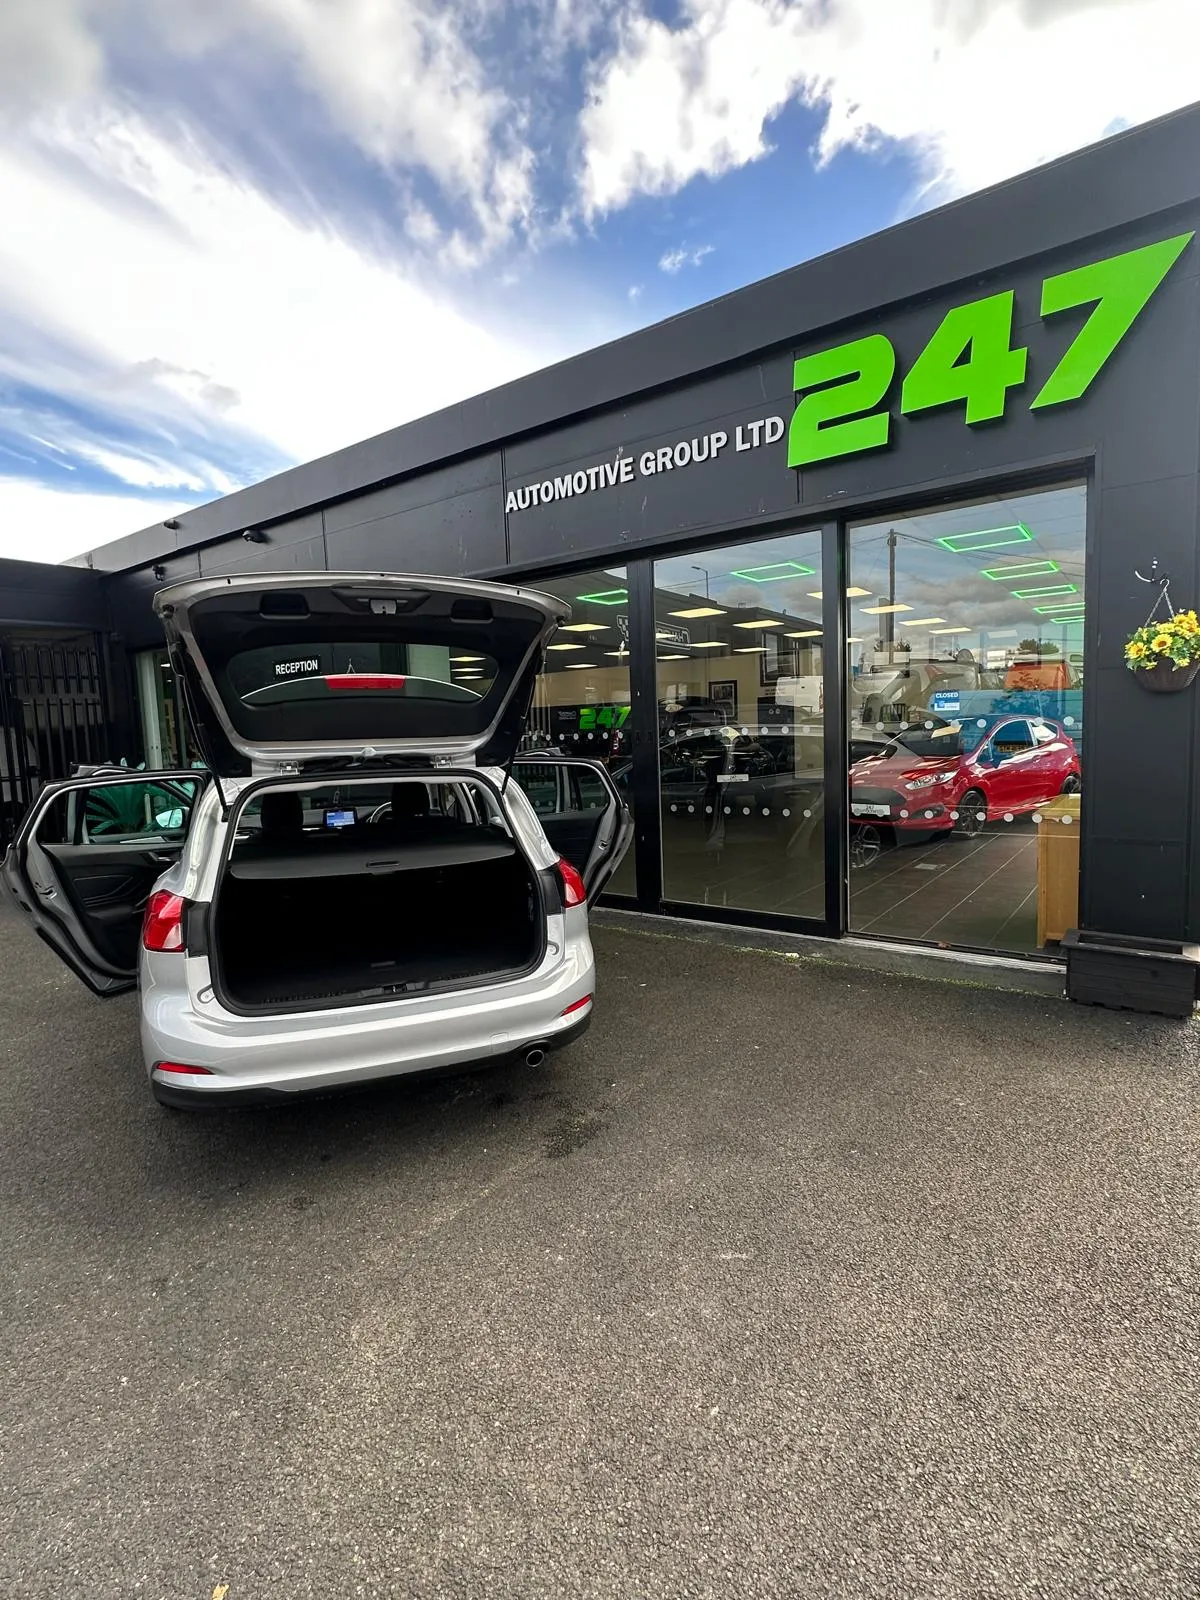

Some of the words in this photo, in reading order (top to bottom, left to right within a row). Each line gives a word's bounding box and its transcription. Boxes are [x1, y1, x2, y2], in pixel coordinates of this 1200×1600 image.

[787, 230, 1196, 469] 247
[505, 457, 634, 514] AUTOMOTIVE
[639, 431, 728, 477] GROUP
[735, 416, 785, 452] LTD
[275, 659, 318, 675] RECEPTION
[579, 706, 631, 730] 247
